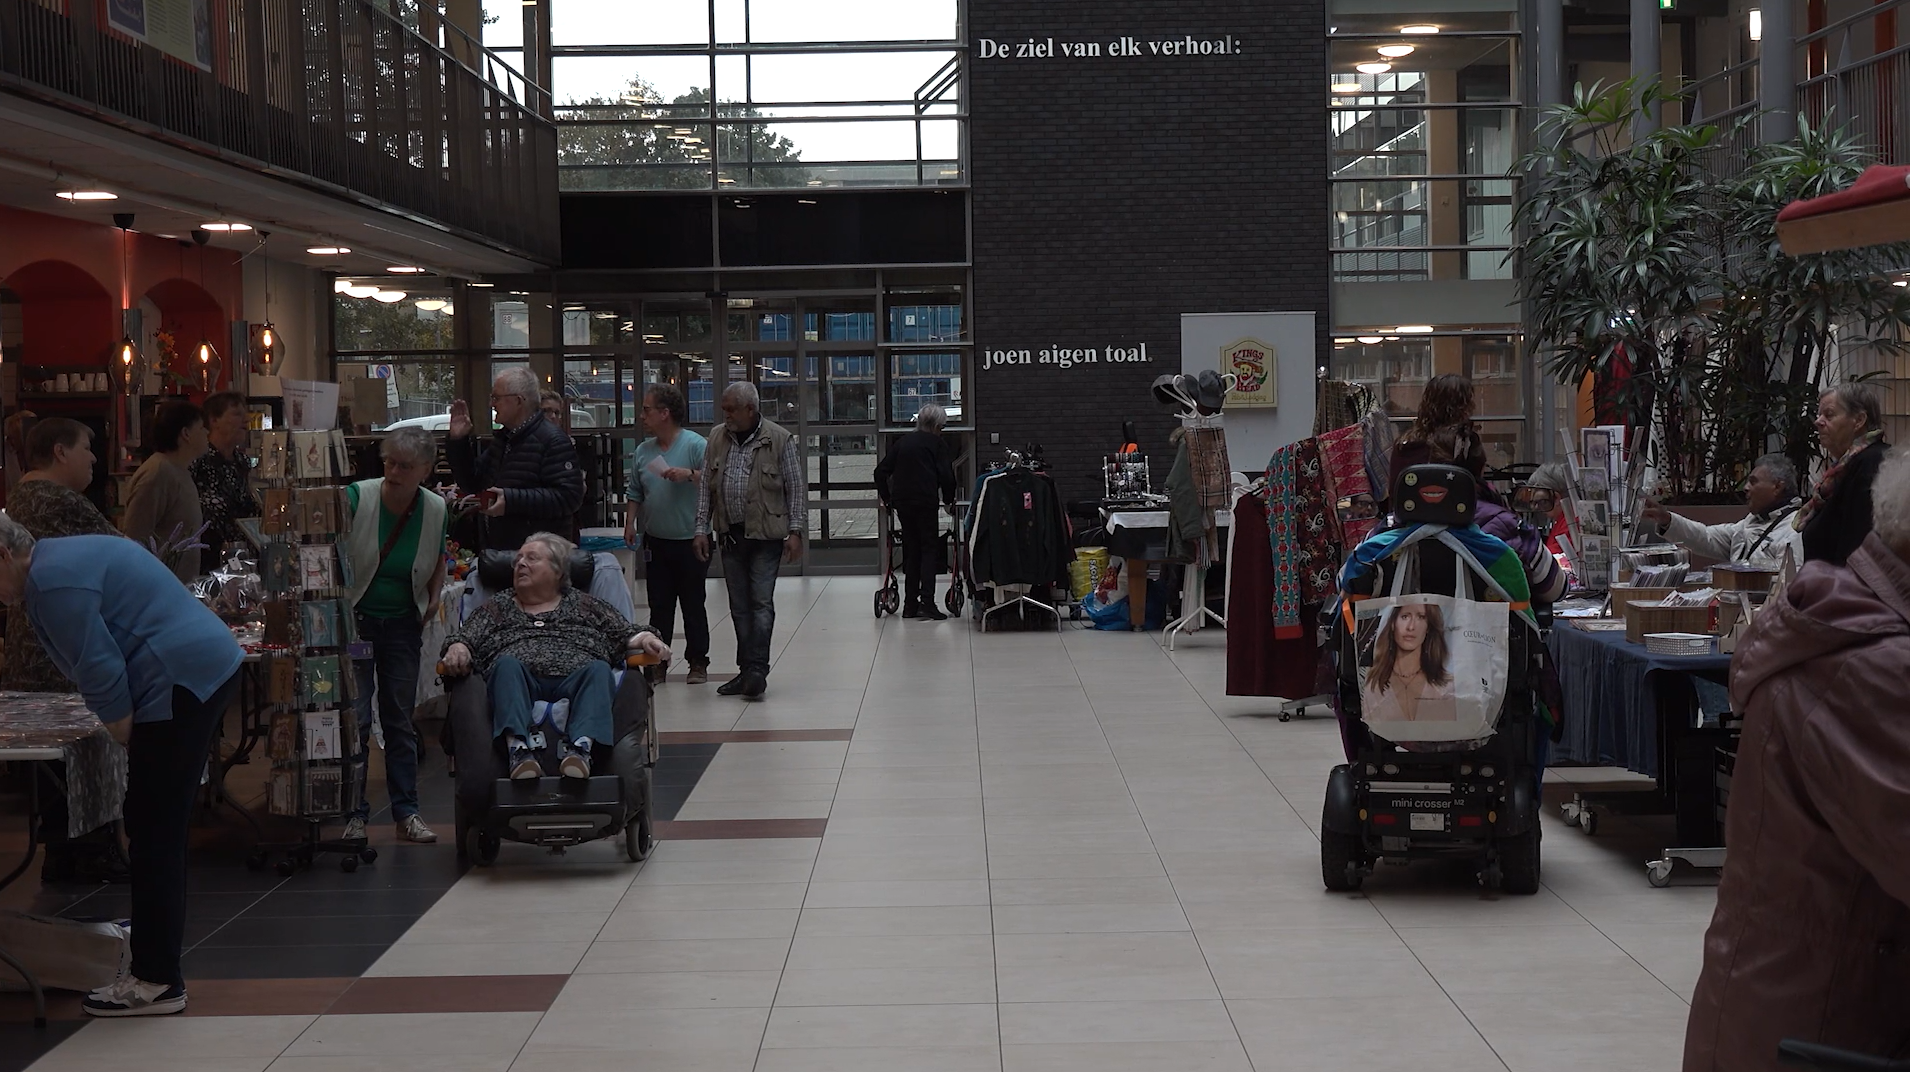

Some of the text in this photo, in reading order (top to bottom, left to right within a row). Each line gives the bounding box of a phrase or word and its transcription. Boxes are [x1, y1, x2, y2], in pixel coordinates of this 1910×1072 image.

[979, 34, 1241, 59] De ziel van elk verhoal:
[982, 342, 1153, 370] joen aigen toal.
[1232, 349, 1264, 363] KINGS
[1236, 381, 1261, 392] HEAD
[1391, 797, 1413, 808] mini
[1414, 799, 1452, 809] crosser
